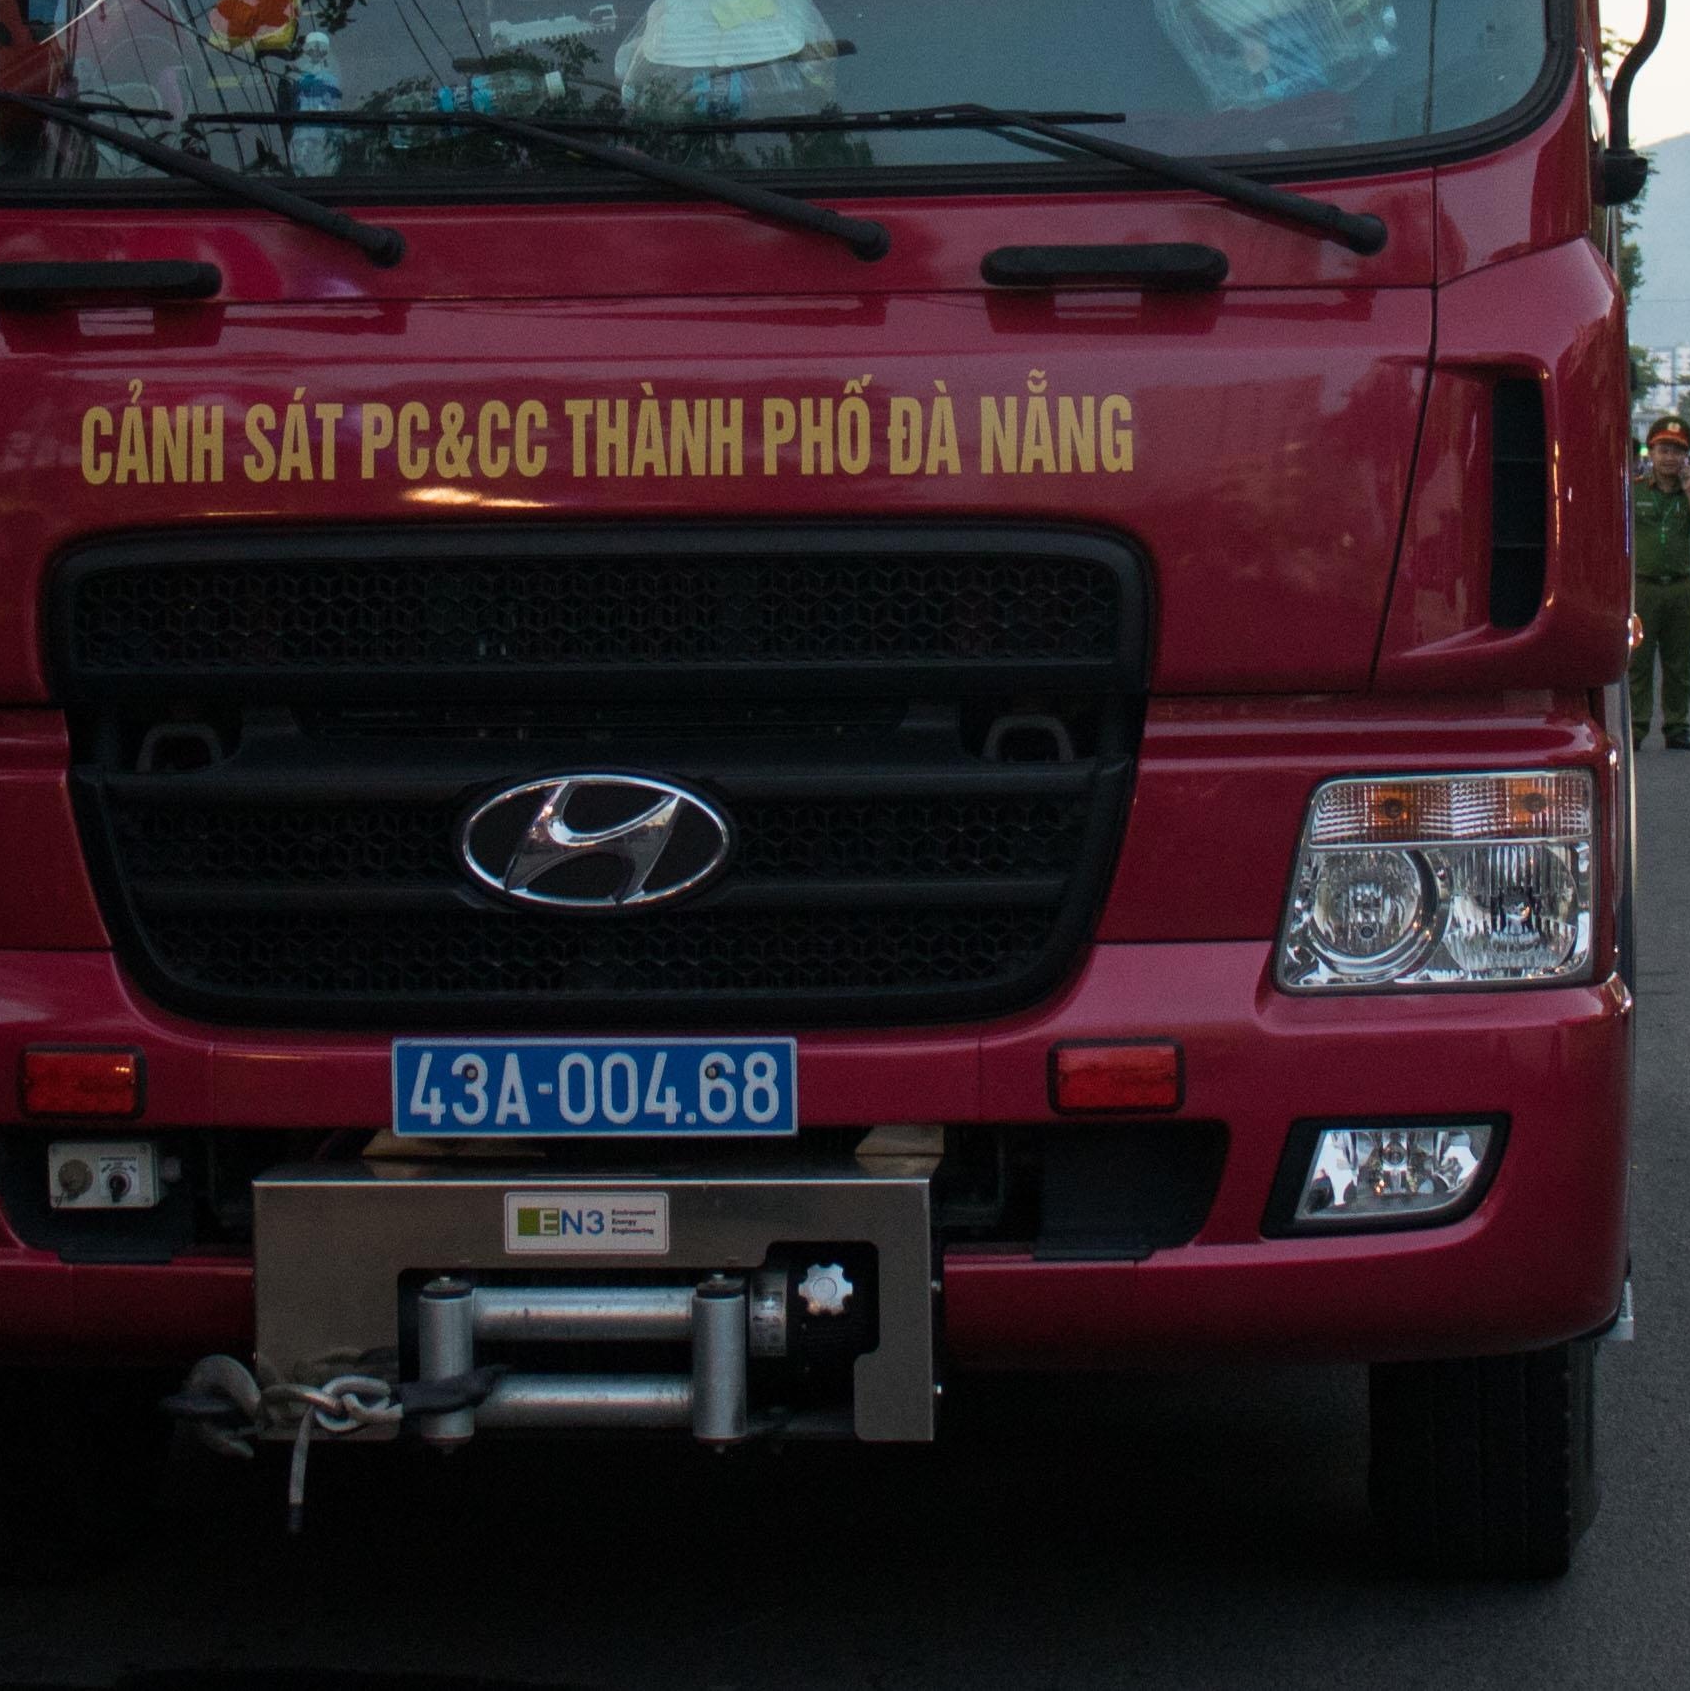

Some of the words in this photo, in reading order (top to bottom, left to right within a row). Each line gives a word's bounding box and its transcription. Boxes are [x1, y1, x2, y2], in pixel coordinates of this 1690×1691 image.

[81, 378, 225, 485] CẢNH
[242, 386, 344, 482] SÁT
[361, 399, 549, 480] PC&CC
[565, 381, 745, 478] THÀNH
[763, 374, 873, 477] PHỐ
[887, 380, 962, 476] ĐÀ
[980, 368, 1135, 475] NẴNG
[408, 1050, 781, 1127] 43A-004.68
[539, 1207, 605, 1236] EN3
